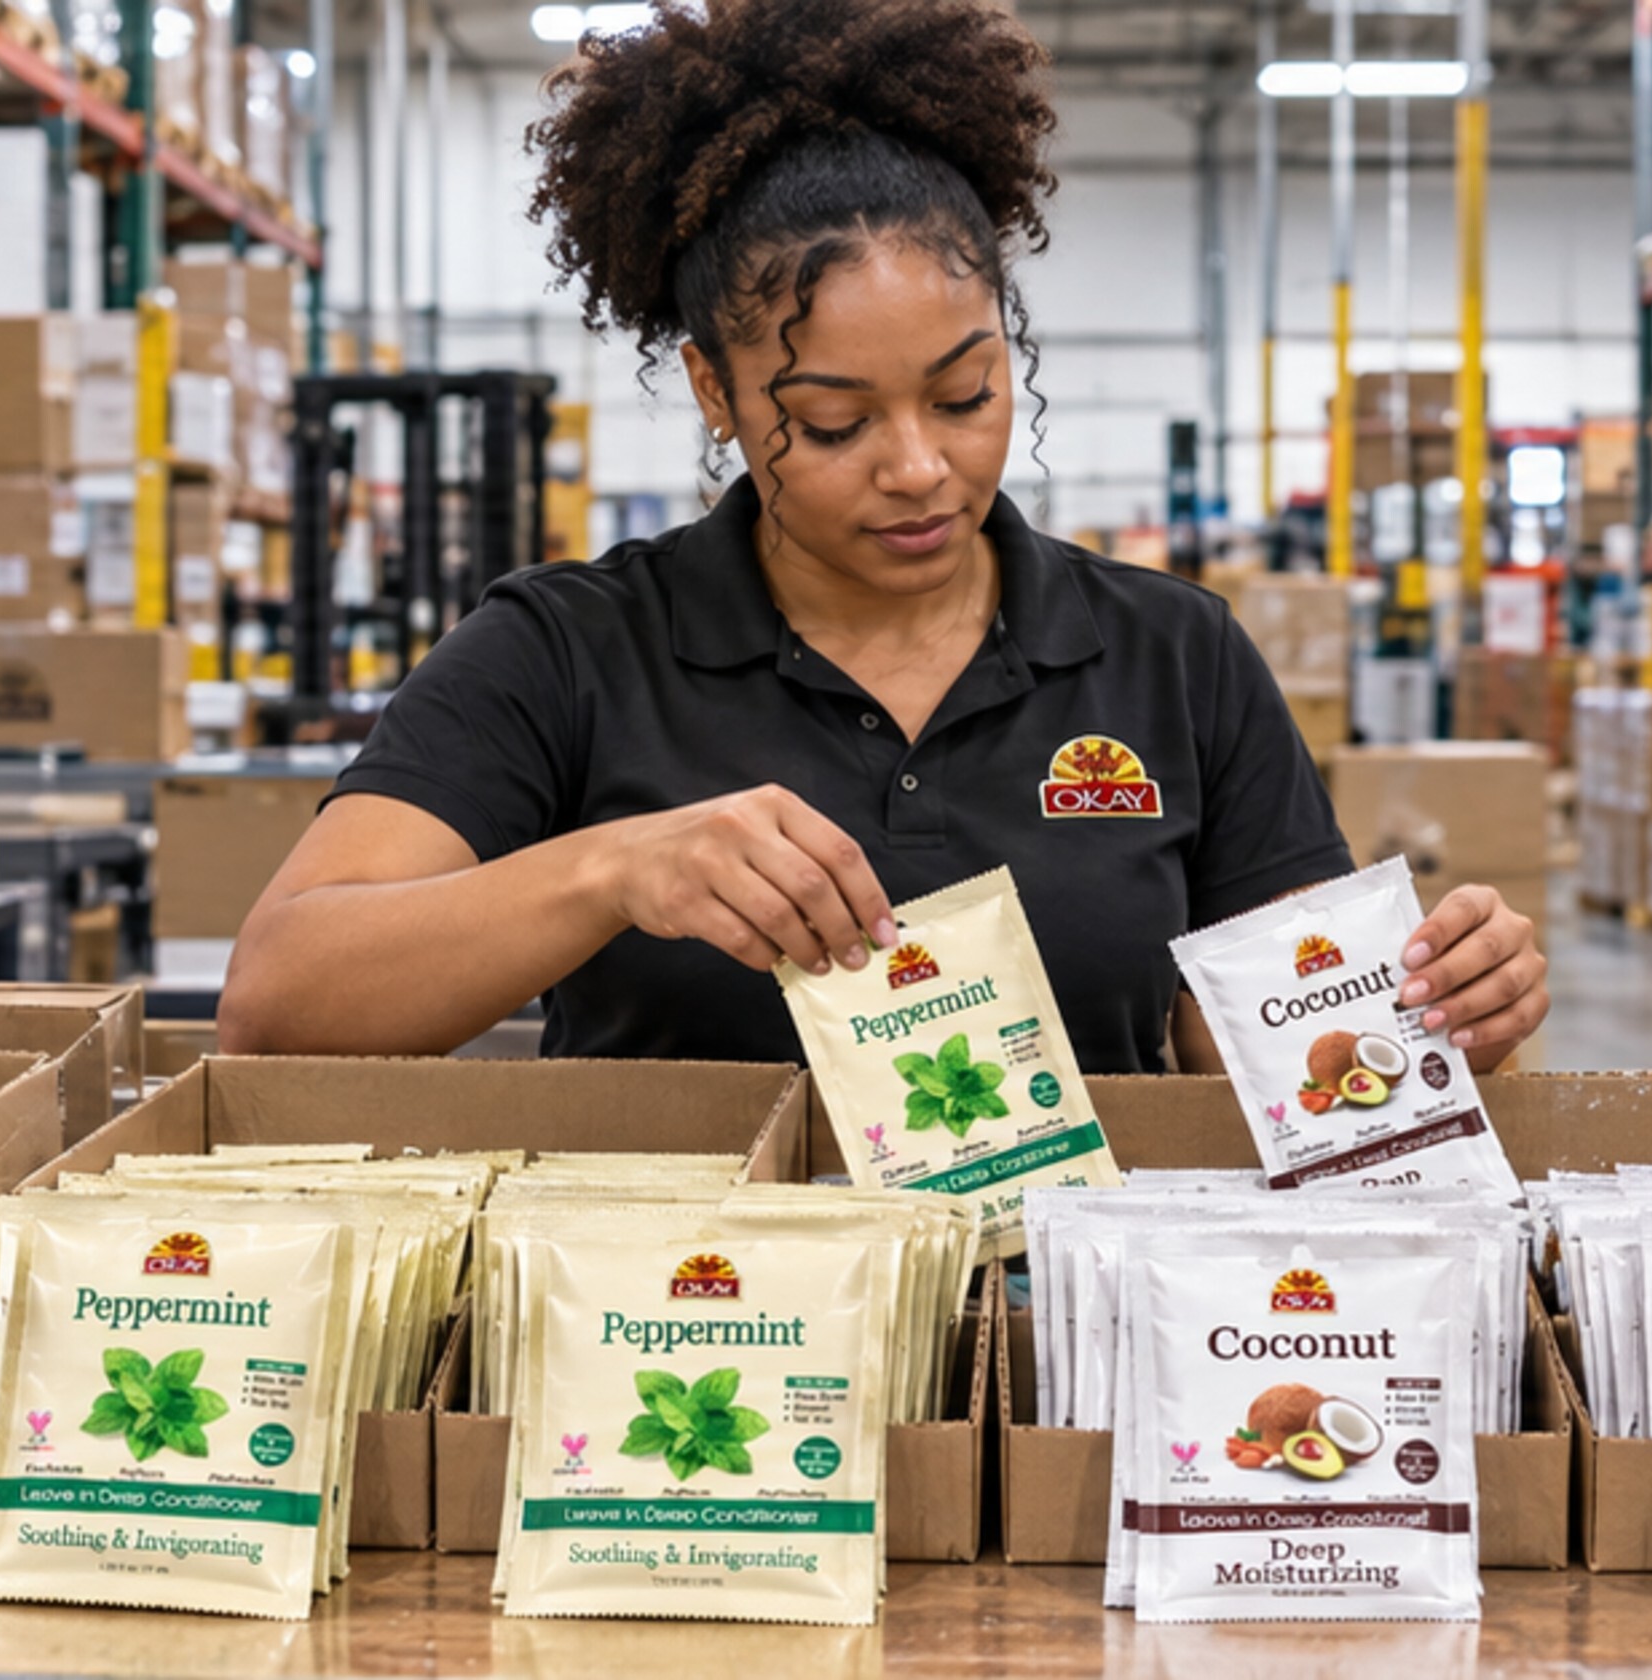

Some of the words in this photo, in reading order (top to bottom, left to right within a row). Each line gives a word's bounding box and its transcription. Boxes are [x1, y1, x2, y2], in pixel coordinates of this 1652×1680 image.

[1053, 787, 1148, 812] OKAY
[849, 974, 999, 1045] Peppermint
[1260, 961, 1396, 1029] Coconut
[72, 1287, 272, 1329] Peppermint
[599, 1311, 806, 1353] Peppermint
[1207, 1326, 1397, 1360] Coconut
[17, 1522, 109, 1553] Soothing
[112, 1527, 130, 1549] &
[134, 1528, 265, 1565] Invigorating
[567, 1542, 659, 1570] Soothing
[663, 1543, 683, 1565] &
[686, 1542, 819, 1573] Invigorating
[1269, 1537, 1347, 1567] Deep
[1213, 1561, 1400, 1589] Moisturizing
